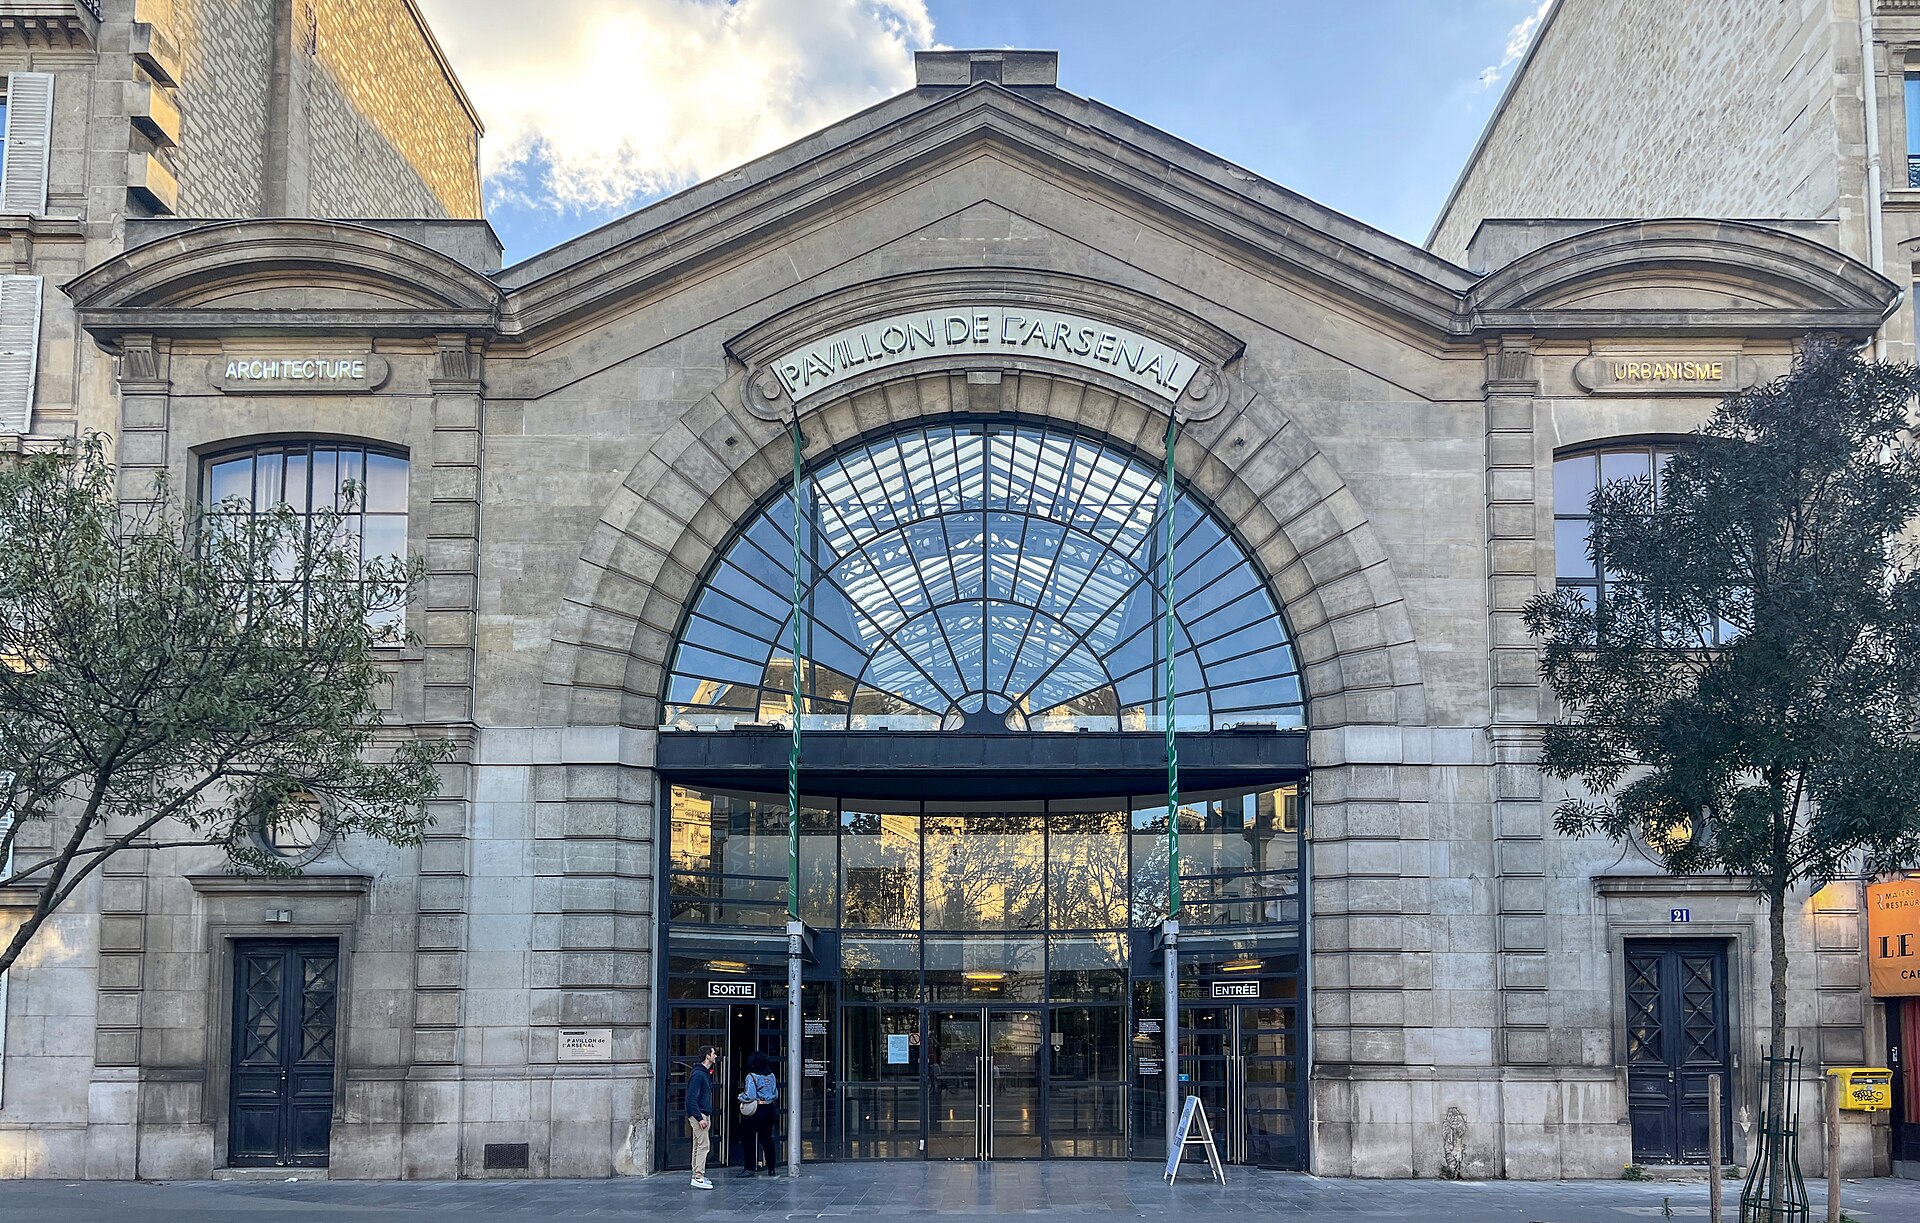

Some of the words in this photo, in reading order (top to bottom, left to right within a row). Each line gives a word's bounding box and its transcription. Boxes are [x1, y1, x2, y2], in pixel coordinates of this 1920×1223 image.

[779, 317, 935, 393] PAVILLON
[945, 313, 989, 345] DE
[1000, 314, 1183, 393] L'ARSENAL
[225, 360, 364, 379] ARCHITECTURE
[1614, 362, 1723, 380] URBANISME
[789, 703, 799, 857] PAVILLON
[1168, 701, 1178, 855] PAVILLON
[1673, 910, 1687, 921] 21
[1878, 933, 1914, 958] LE
[712, 985, 752, 995] SORTIE
[1215, 984, 1257, 996] ENTRÉE
